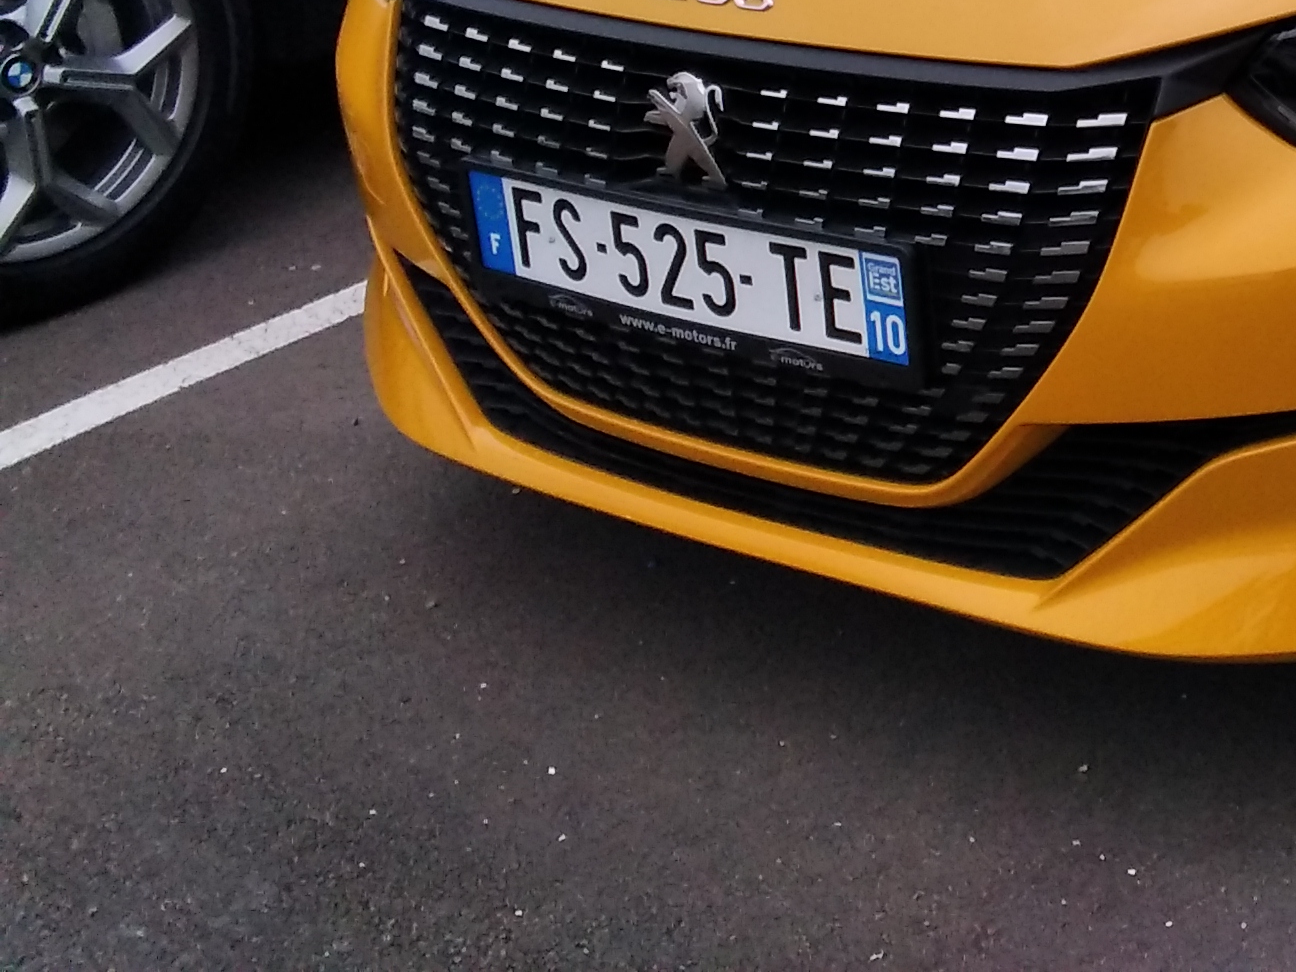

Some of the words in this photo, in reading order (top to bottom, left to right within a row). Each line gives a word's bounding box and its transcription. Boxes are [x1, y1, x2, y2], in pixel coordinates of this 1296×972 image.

[489, 232, 501, 255] F
[511, 186, 863, 345] FS-525-TE
[866, 262, 897, 277] Grand
[868, 271, 898, 293] Est
[618, 313, 737, 351] www.e-motors.fr
[870, 310, 906, 356] 10
